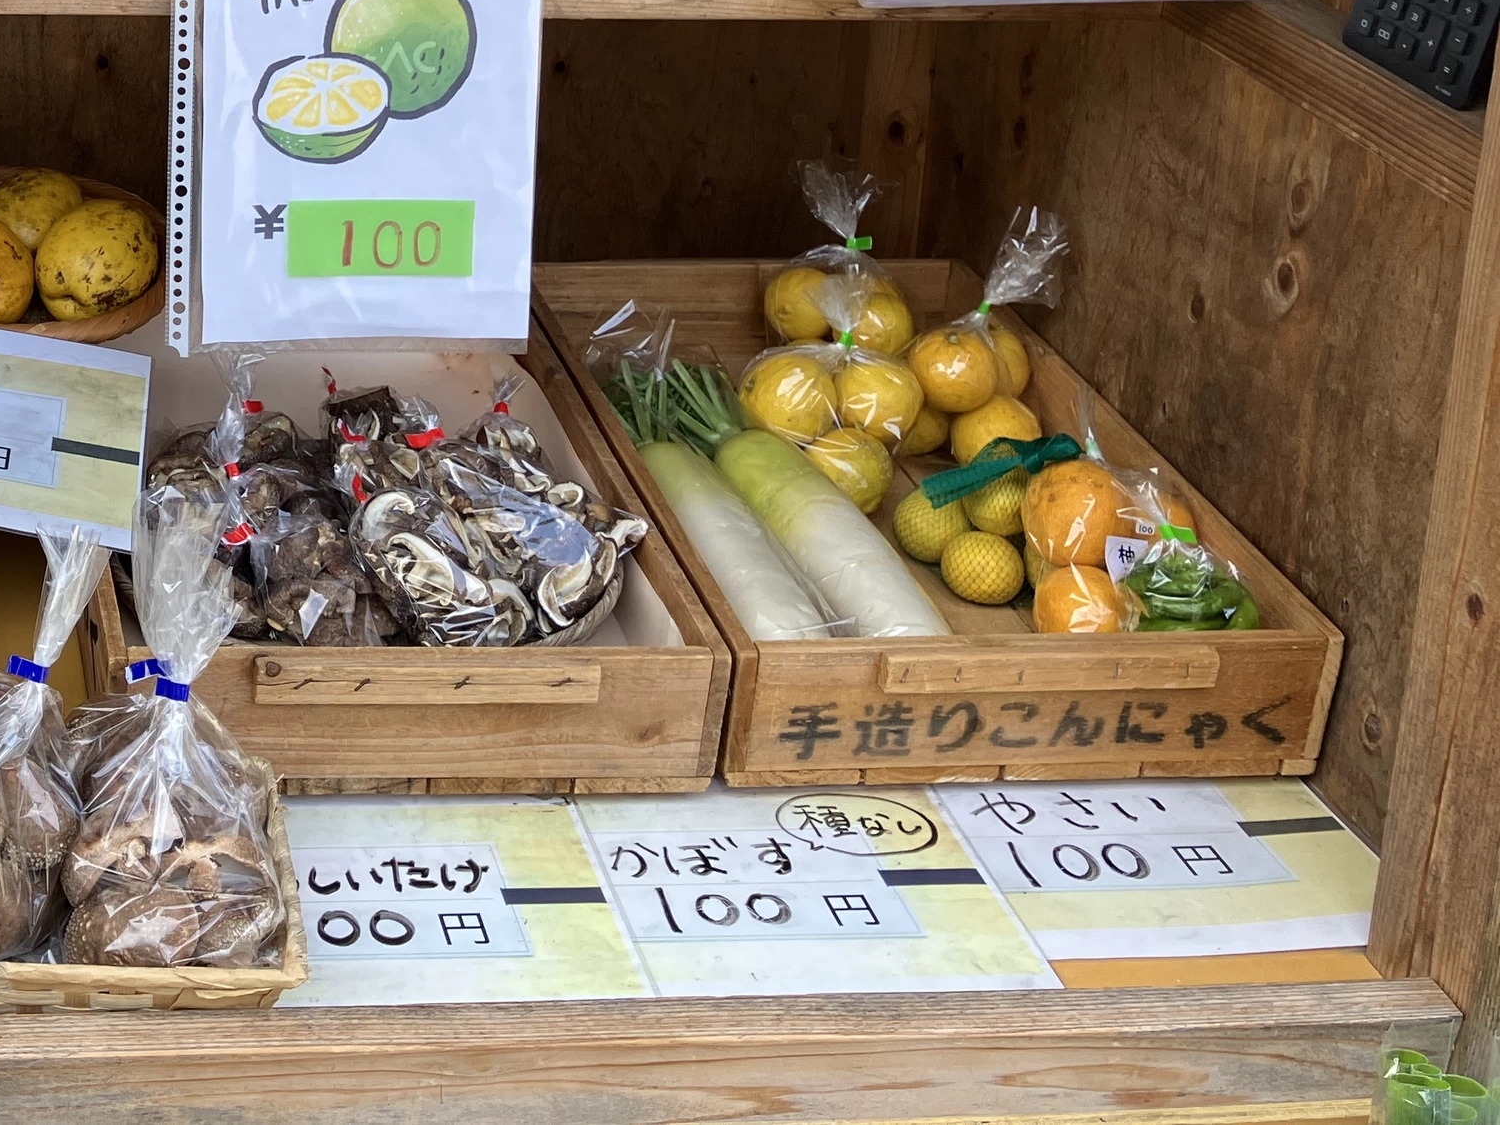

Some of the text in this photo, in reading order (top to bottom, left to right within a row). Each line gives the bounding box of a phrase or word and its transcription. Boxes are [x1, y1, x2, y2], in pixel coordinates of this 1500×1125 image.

[340, 219, 442, 269] 100
[1138, 524, 1154, 535] 100
[777, 695, 1293, 761] 手造りこんにゃく
[792, 803, 924, 840] 種なし
[969, 791, 1168, 835] やさい
[296, 859, 490, 896] しいたけ
[608, 835, 794, 879] かぼす
